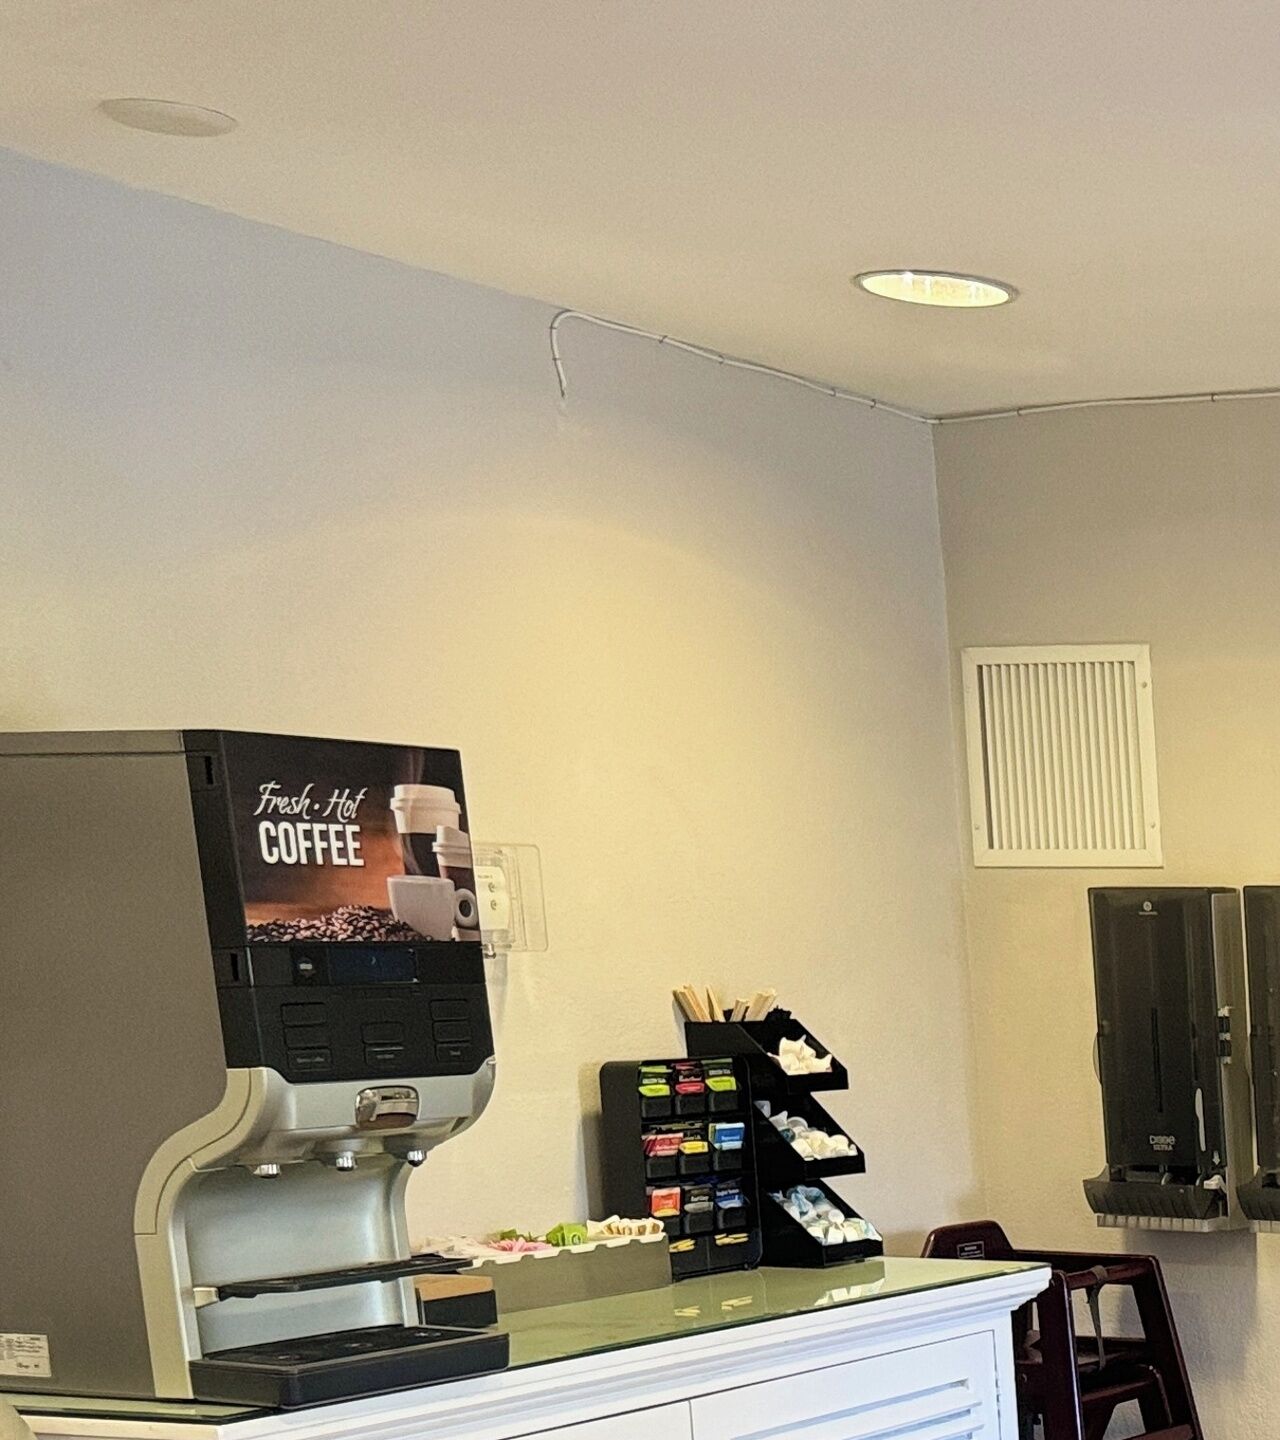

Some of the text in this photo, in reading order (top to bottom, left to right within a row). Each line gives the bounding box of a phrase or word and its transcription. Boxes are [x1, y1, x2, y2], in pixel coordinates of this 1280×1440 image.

[253, 780, 368, 823] Fresh Hot
[259, 820, 365, 867] COFFEE
